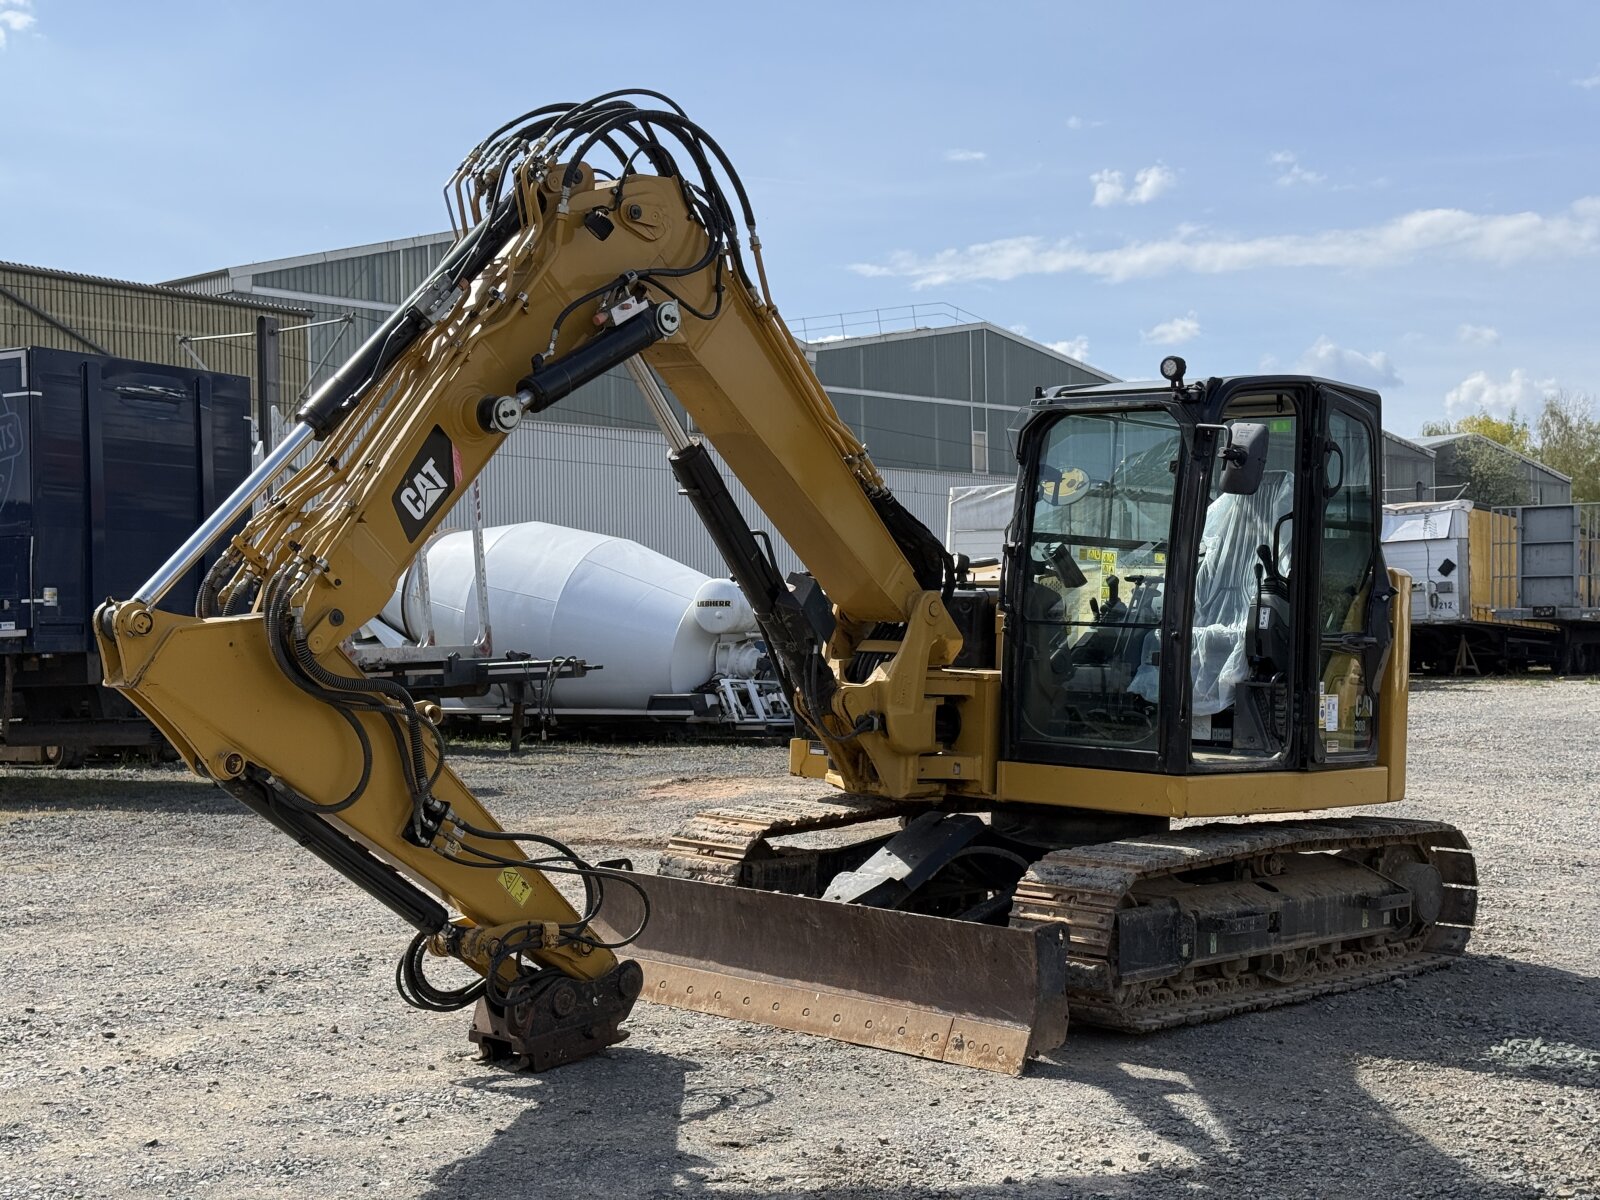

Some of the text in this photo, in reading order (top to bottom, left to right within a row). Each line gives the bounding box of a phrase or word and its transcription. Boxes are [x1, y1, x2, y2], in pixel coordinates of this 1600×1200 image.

[0, 423, 15, 453] TS
[401, 457, 448, 521] CAT
[697, 600, 732, 608] LIEBHERR
[1439, 601, 1453, 610] 212
